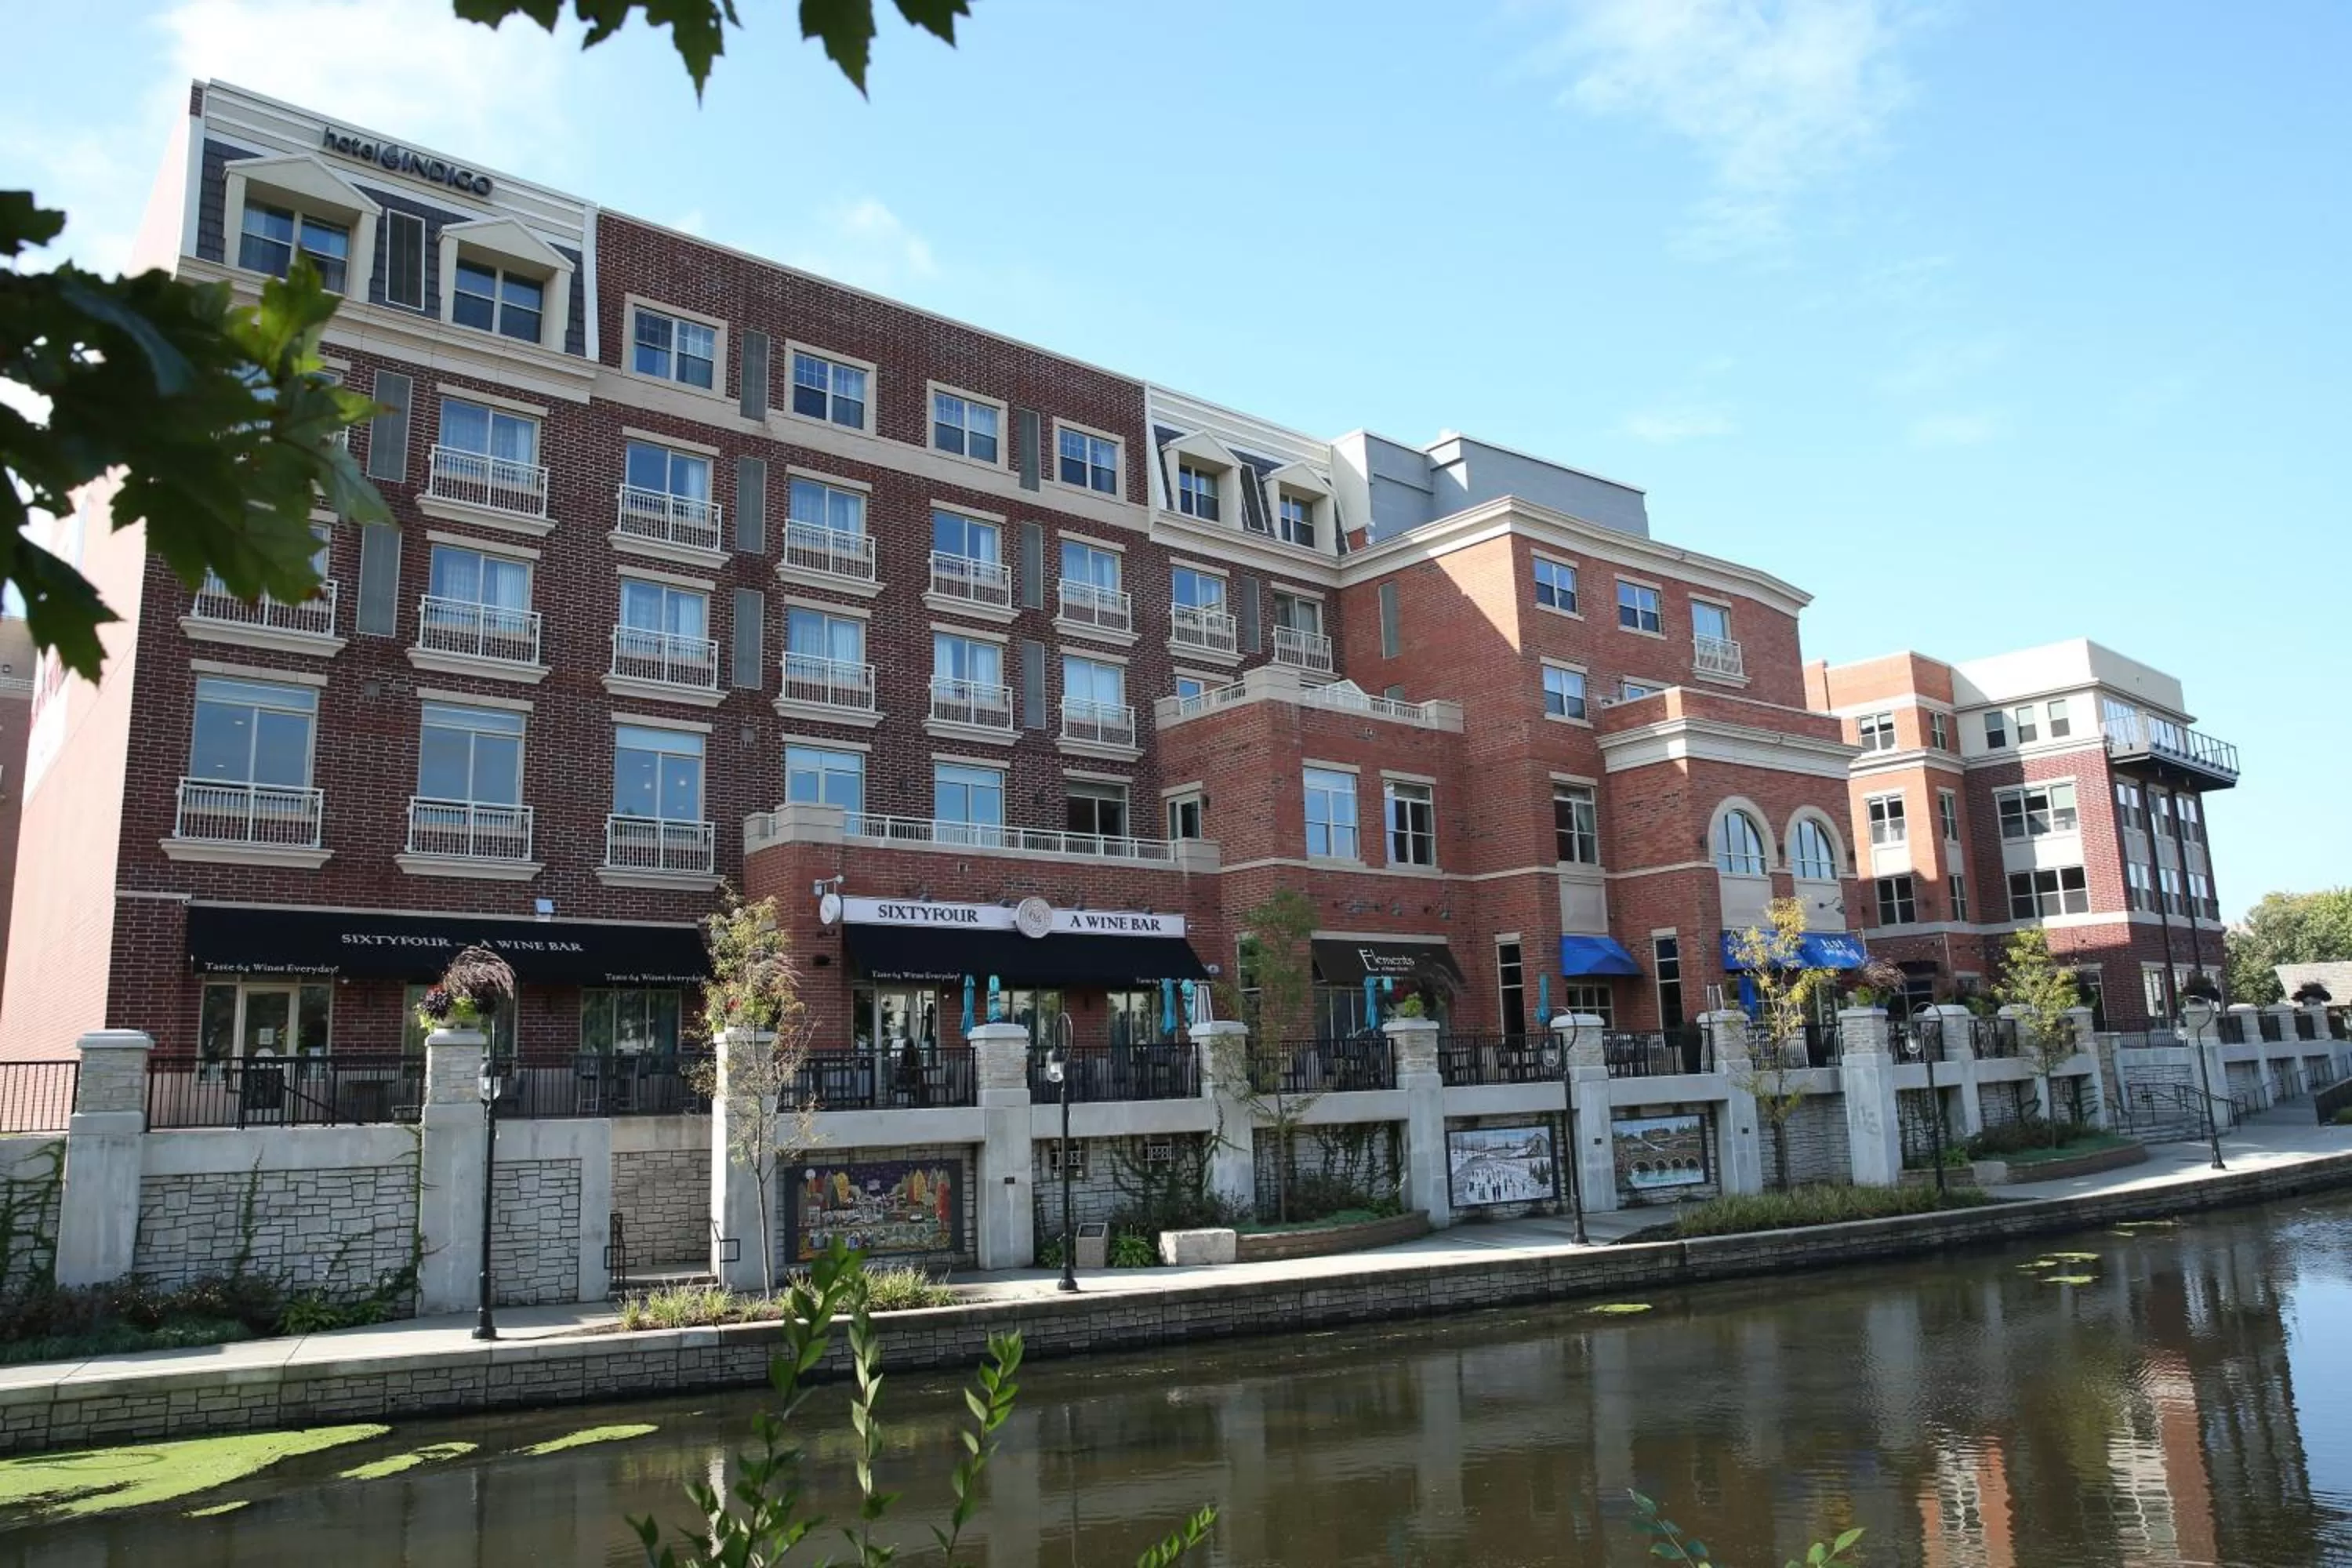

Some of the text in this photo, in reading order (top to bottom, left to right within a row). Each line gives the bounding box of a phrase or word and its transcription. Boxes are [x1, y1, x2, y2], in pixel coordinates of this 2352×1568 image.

[323, 126, 493, 196] hotel INDIGO
[877, 904, 978, 923] SIXTYFOUR
[1070, 915, 1161, 931] A WINE BAR
[341, 934, 584, 952] SIXTYFOUR A WINE BAR
[205, 962, 234, 971] Taste
[236, 963, 249, 972] 64
[287, 964, 339, 975] Everyday!
